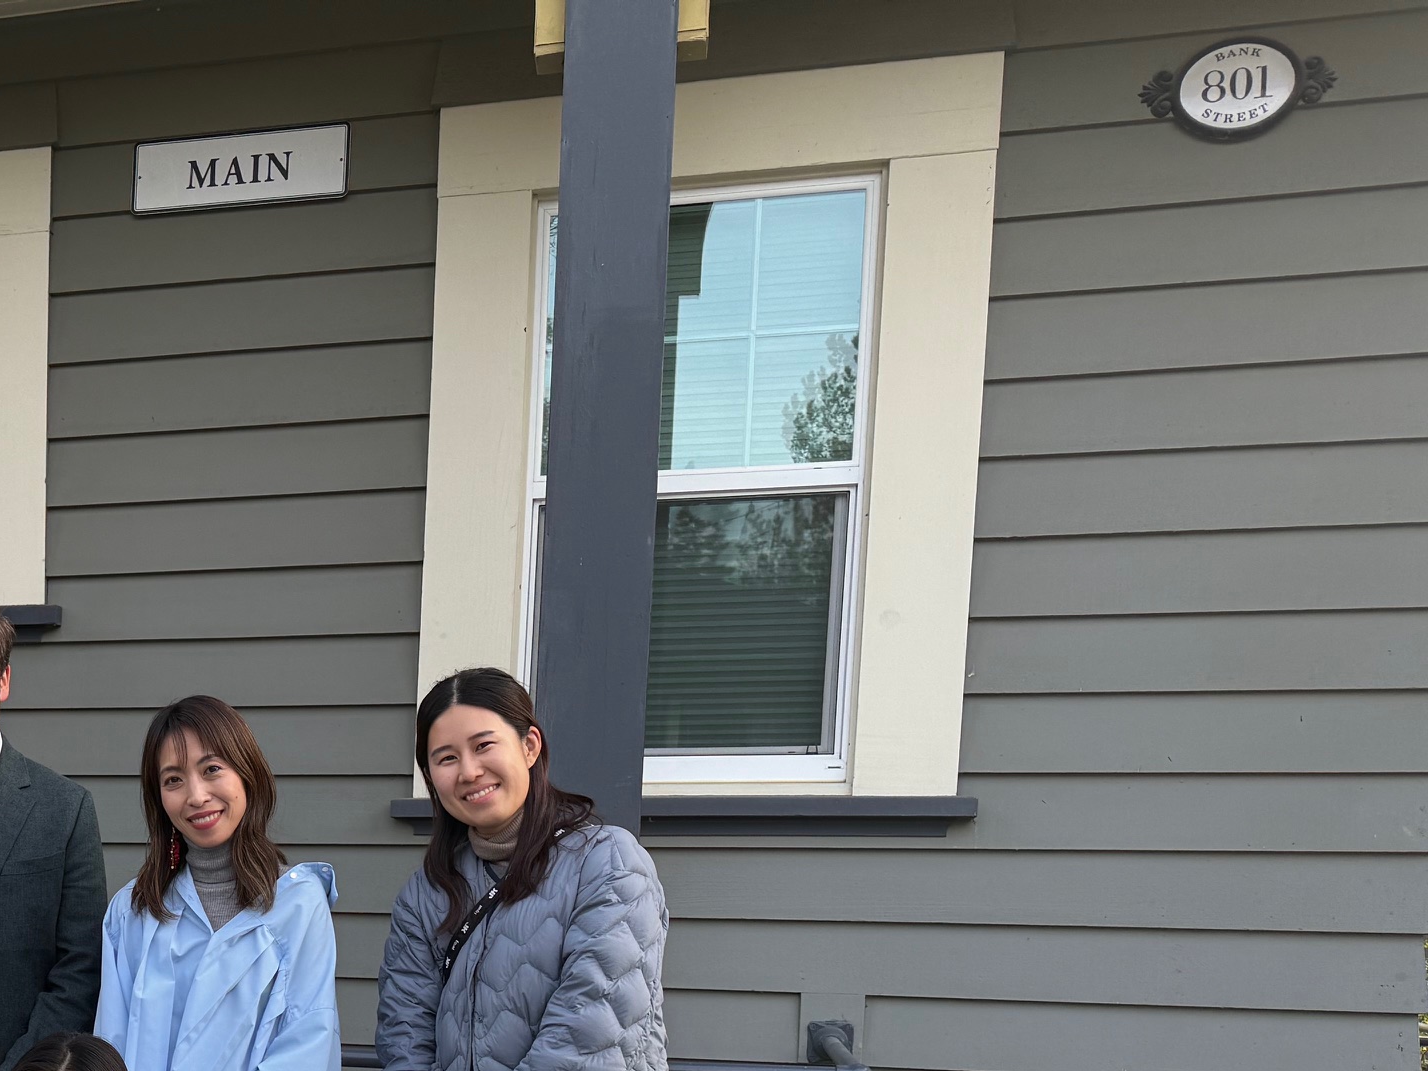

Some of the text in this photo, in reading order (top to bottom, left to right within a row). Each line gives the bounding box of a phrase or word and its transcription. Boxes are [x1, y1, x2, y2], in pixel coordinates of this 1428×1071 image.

[1214, 46, 1262, 62] BANK
[1201, 65, 1273, 103] 801
[1201, 102, 1269, 123] STREET
[186, 151, 293, 189] MAIN
